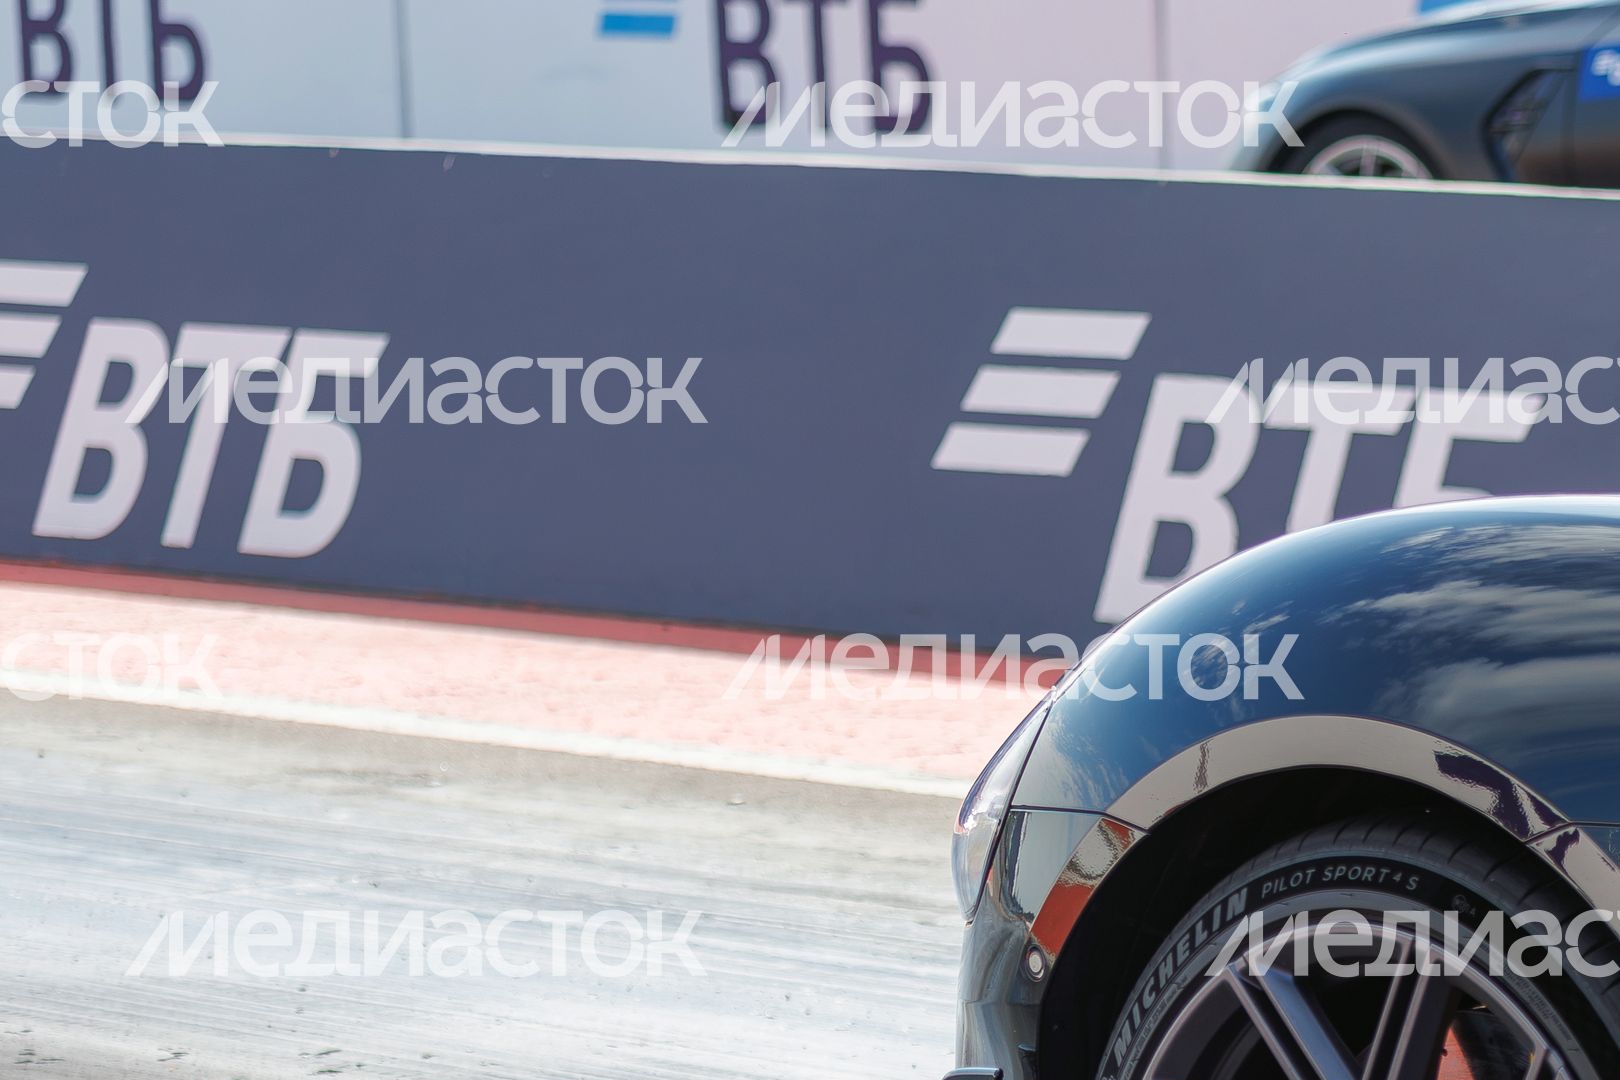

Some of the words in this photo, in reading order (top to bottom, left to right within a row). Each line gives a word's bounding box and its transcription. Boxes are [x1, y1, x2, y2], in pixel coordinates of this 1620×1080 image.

[32, 317, 391, 560] ВТБ
[1261, 868, 1316, 899] PILOT
[1322, 865, 1391, 884] SPORT
[1405, 876, 1420, 891] S
[1113, 886, 1249, 1067] MICHELIN
